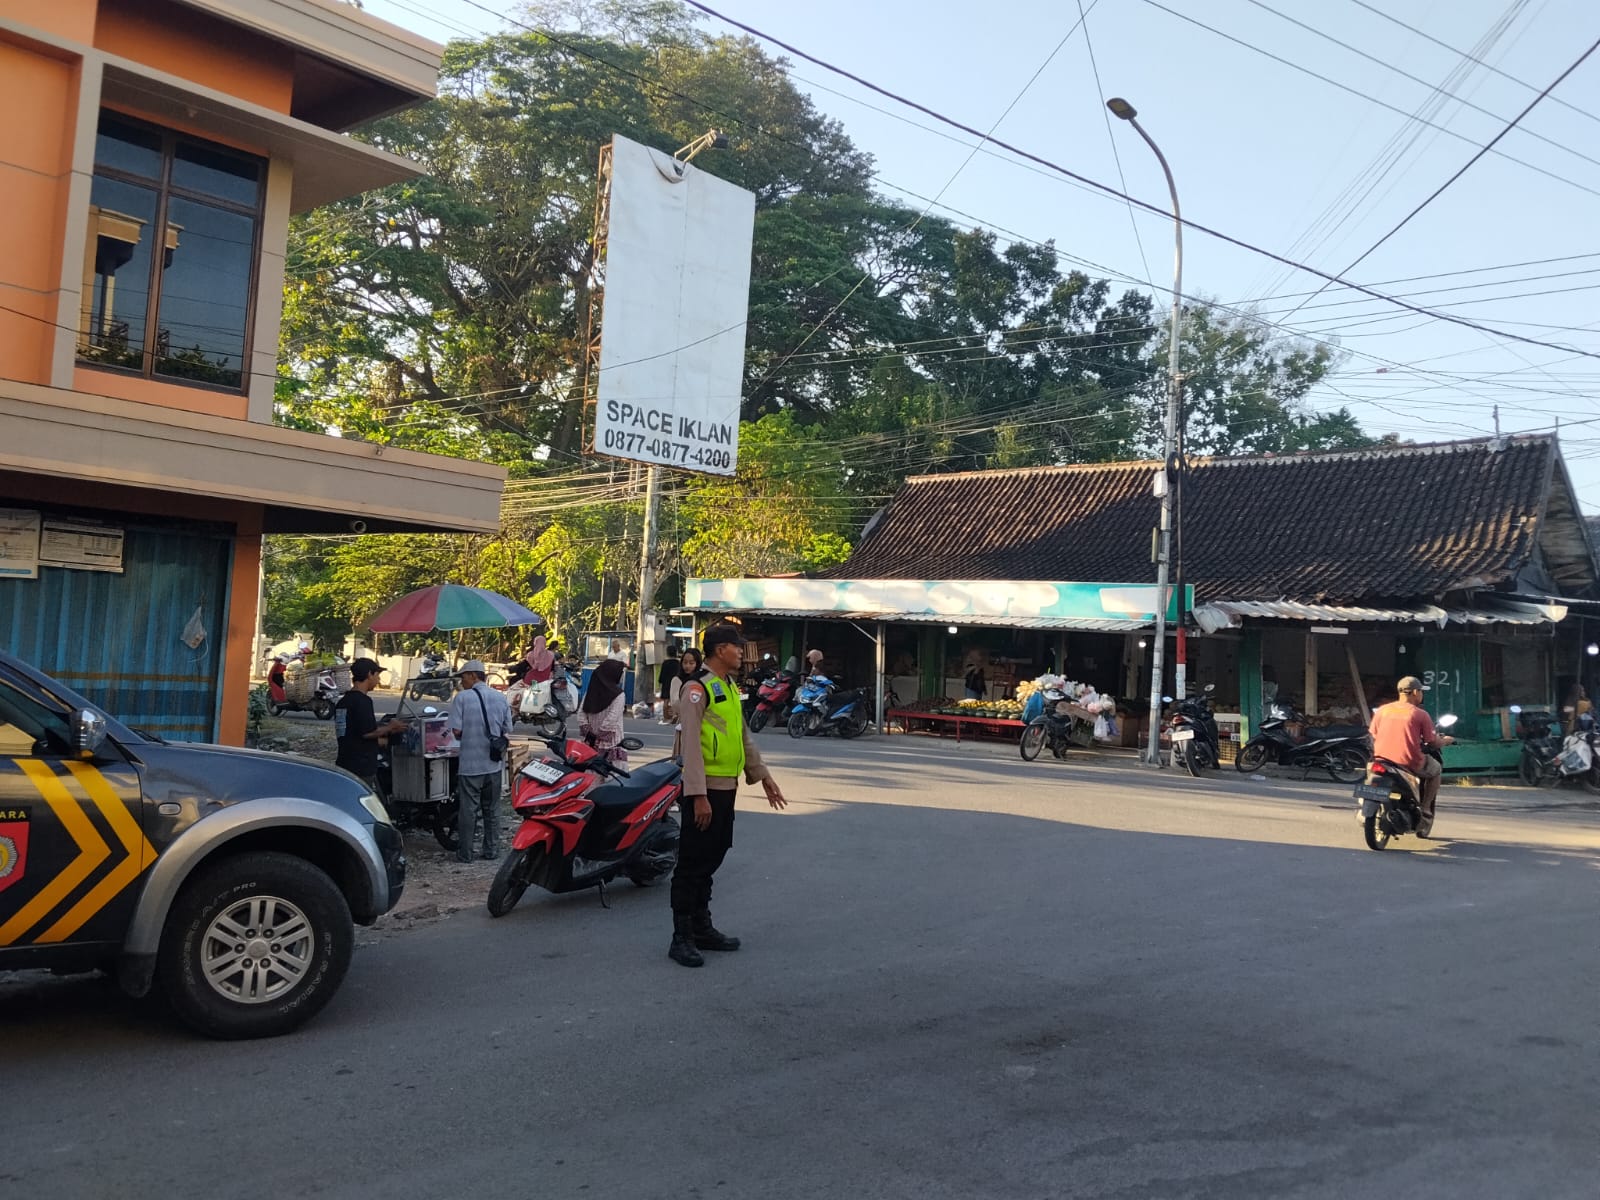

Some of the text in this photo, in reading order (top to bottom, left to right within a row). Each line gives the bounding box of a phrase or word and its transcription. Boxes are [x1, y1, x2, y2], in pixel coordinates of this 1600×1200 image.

[607, 400, 732, 445] SPACE IKLAN
[604, 428, 730, 469] 0877-0877-4200
[1423, 669, 1460, 693] 321
[233, 882, 257, 893] PRO
